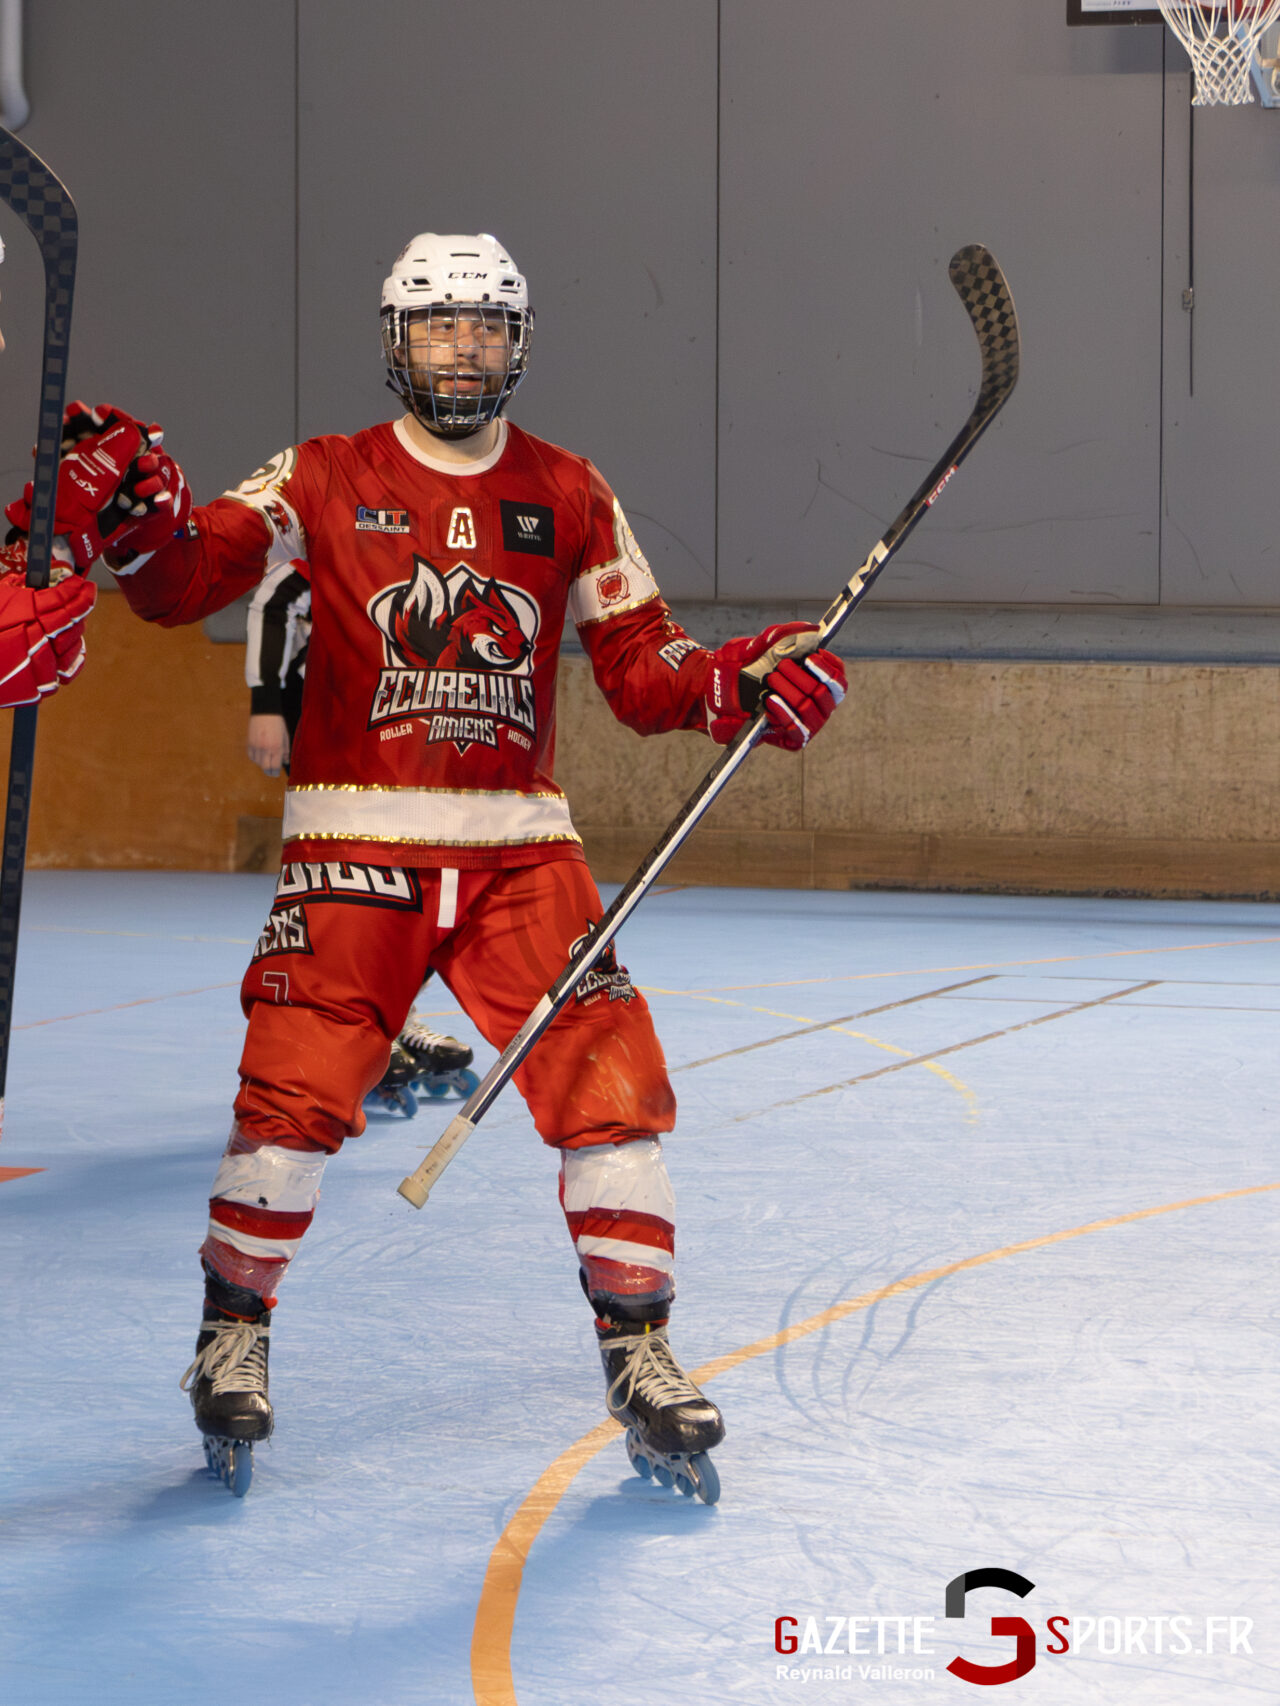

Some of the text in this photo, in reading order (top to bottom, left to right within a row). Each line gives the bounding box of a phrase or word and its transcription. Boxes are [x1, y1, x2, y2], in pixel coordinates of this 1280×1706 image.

[929, 467, 955, 505] CCM
[357, 506, 406, 525] CIT
[359, 522, 406, 533] DESSAINT
[446, 507, 477, 549] A
[82, 533, 94, 558] CCM
[818, 540, 889, 638] CM
[370, 670, 536, 733] ECUREUILS
[713, 667, 722, 708] CCM
[380, 723, 532, 751] ROLLER HOCKEY
[428, 715, 497, 745] AMIENS
